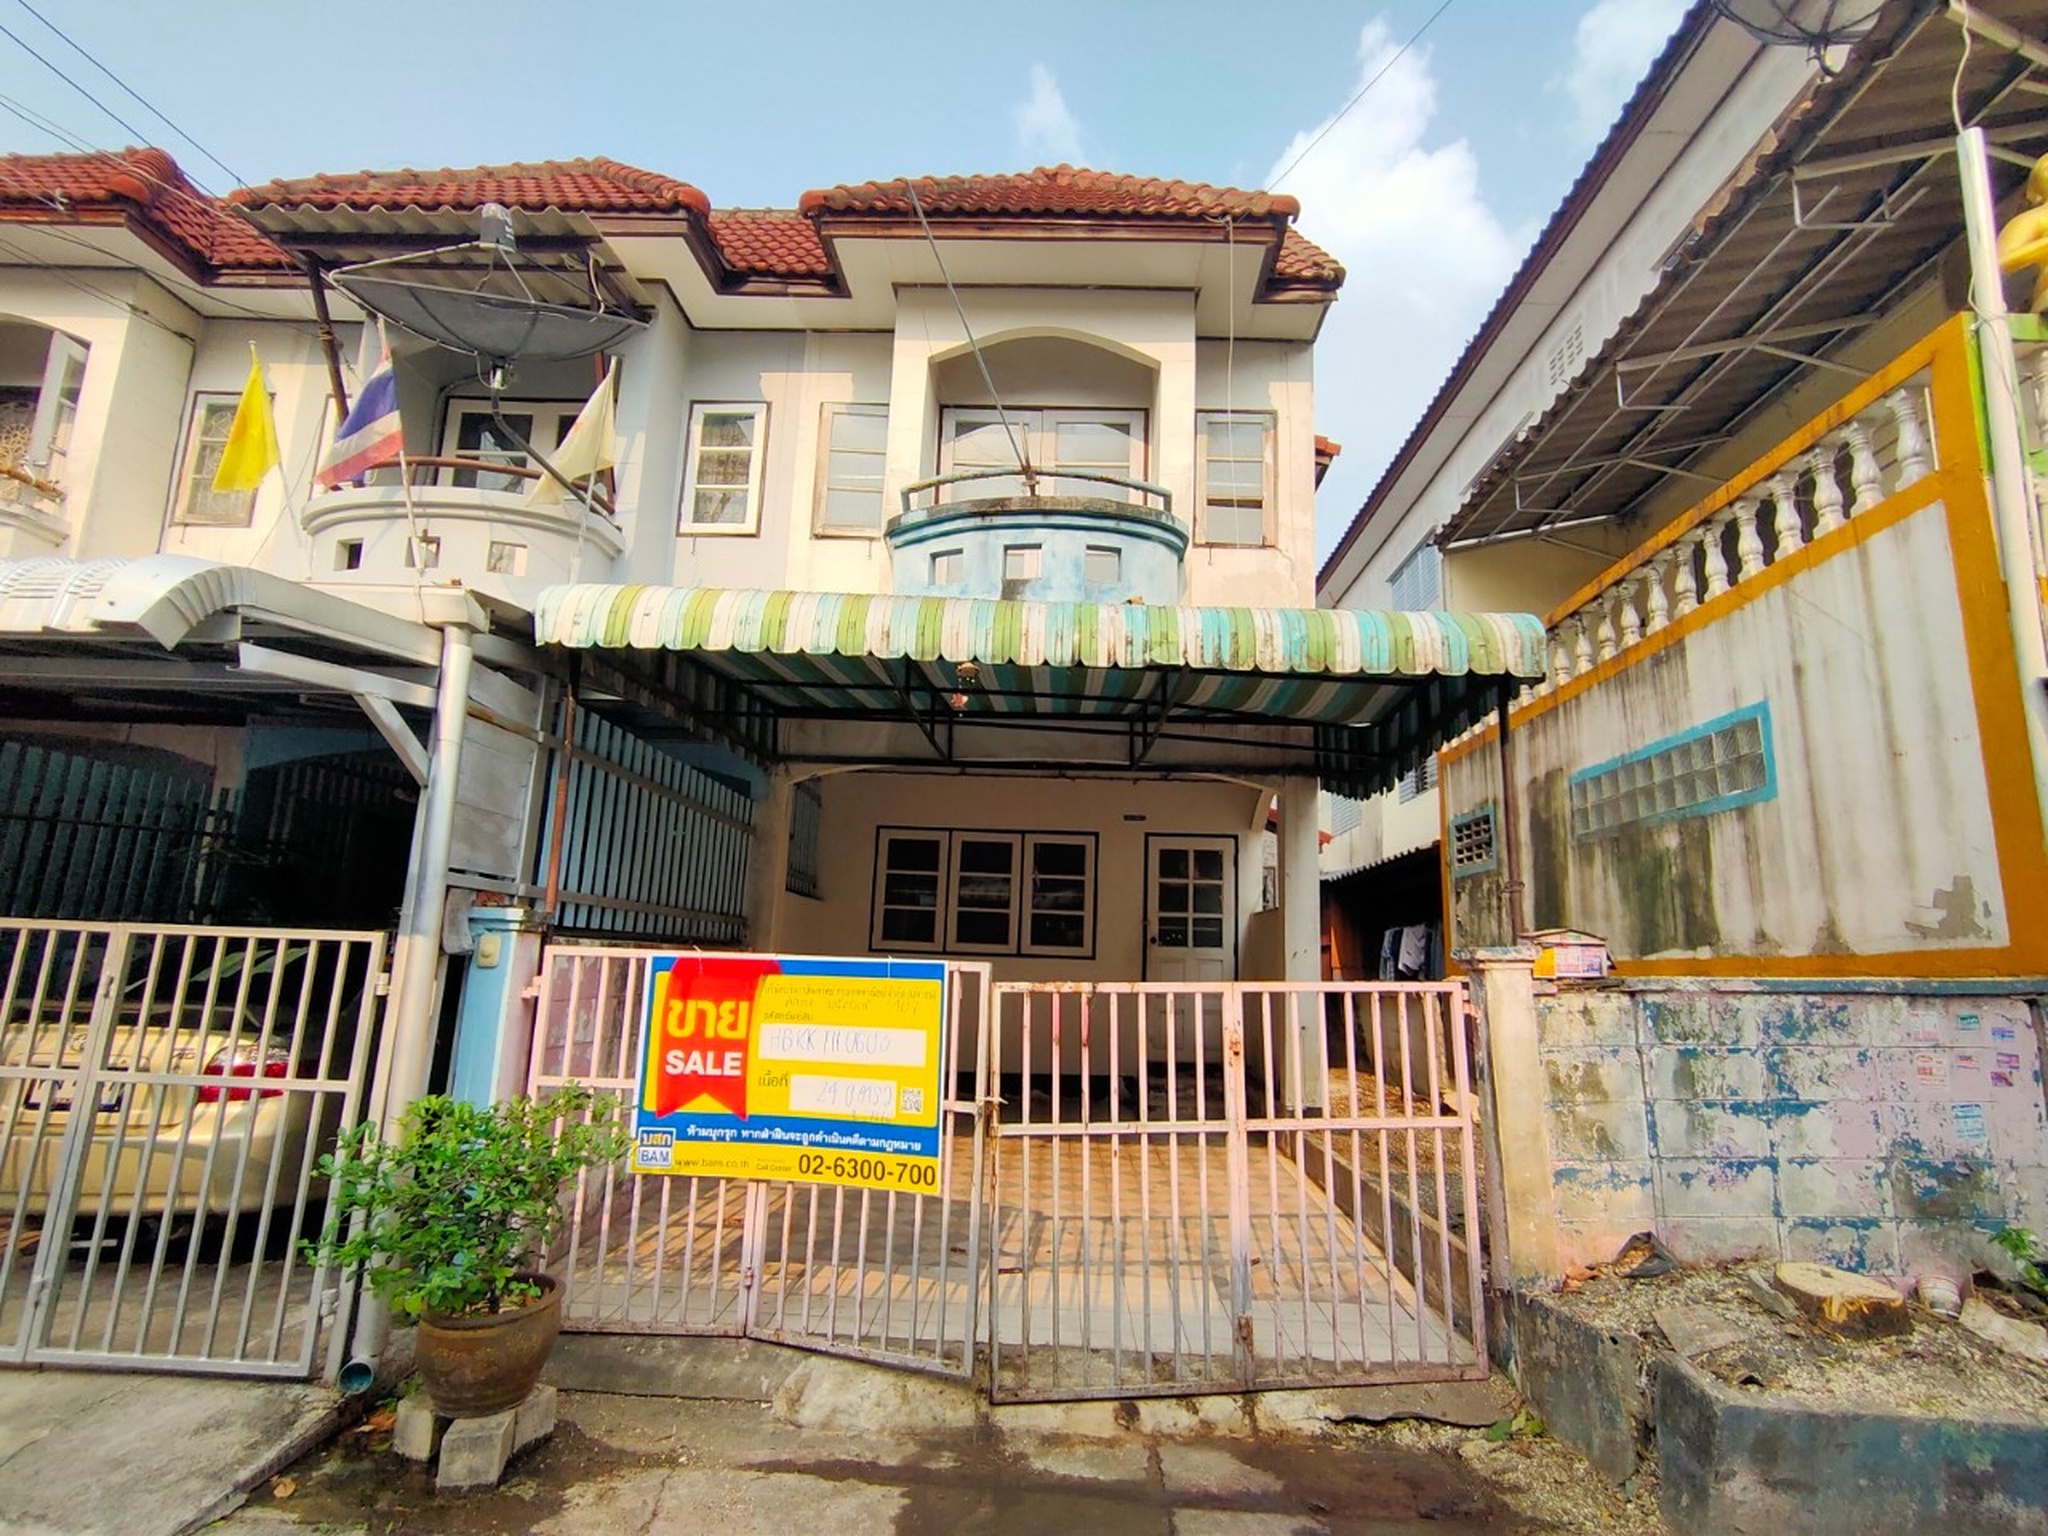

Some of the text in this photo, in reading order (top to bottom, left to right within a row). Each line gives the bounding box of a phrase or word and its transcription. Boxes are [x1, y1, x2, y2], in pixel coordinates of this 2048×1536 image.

[667, 999, 750, 1039] ขาย
[665, 1049, 743, 1076] SALE
[758, 1069, 789, 1088] เนื้อที่
[641, 1132, 671, 1146] บสก
[686, 1124, 737, 1141] ห้ามบุกรุก
[641, 1149, 670, 1163] BAM
[798, 1153, 936, 1187] 02-6300-700
